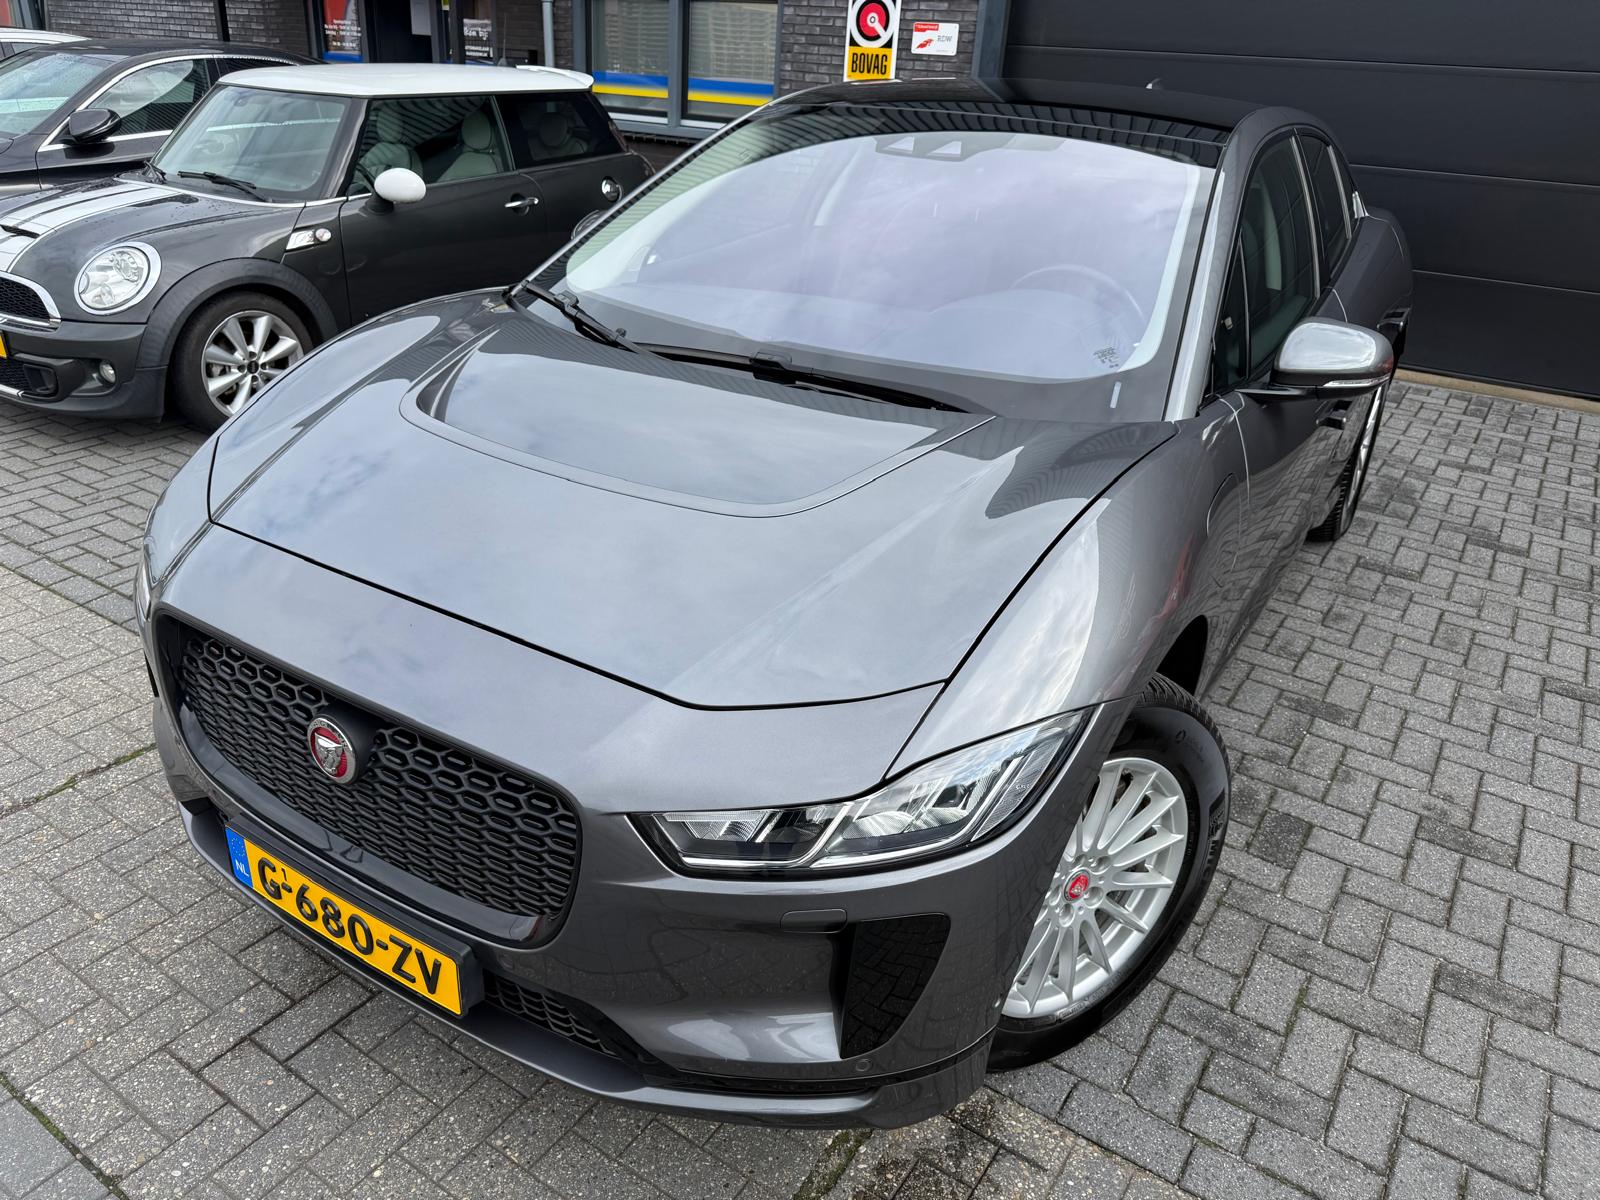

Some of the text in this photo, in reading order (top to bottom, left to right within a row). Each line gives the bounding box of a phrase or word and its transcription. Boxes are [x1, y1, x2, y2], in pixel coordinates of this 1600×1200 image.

[851, 53, 888, 75] BOVAG
[235, 859, 249, 877] NL
[281, 868, 287, 881] 1
[258, 857, 441, 995] G-680-ZV
